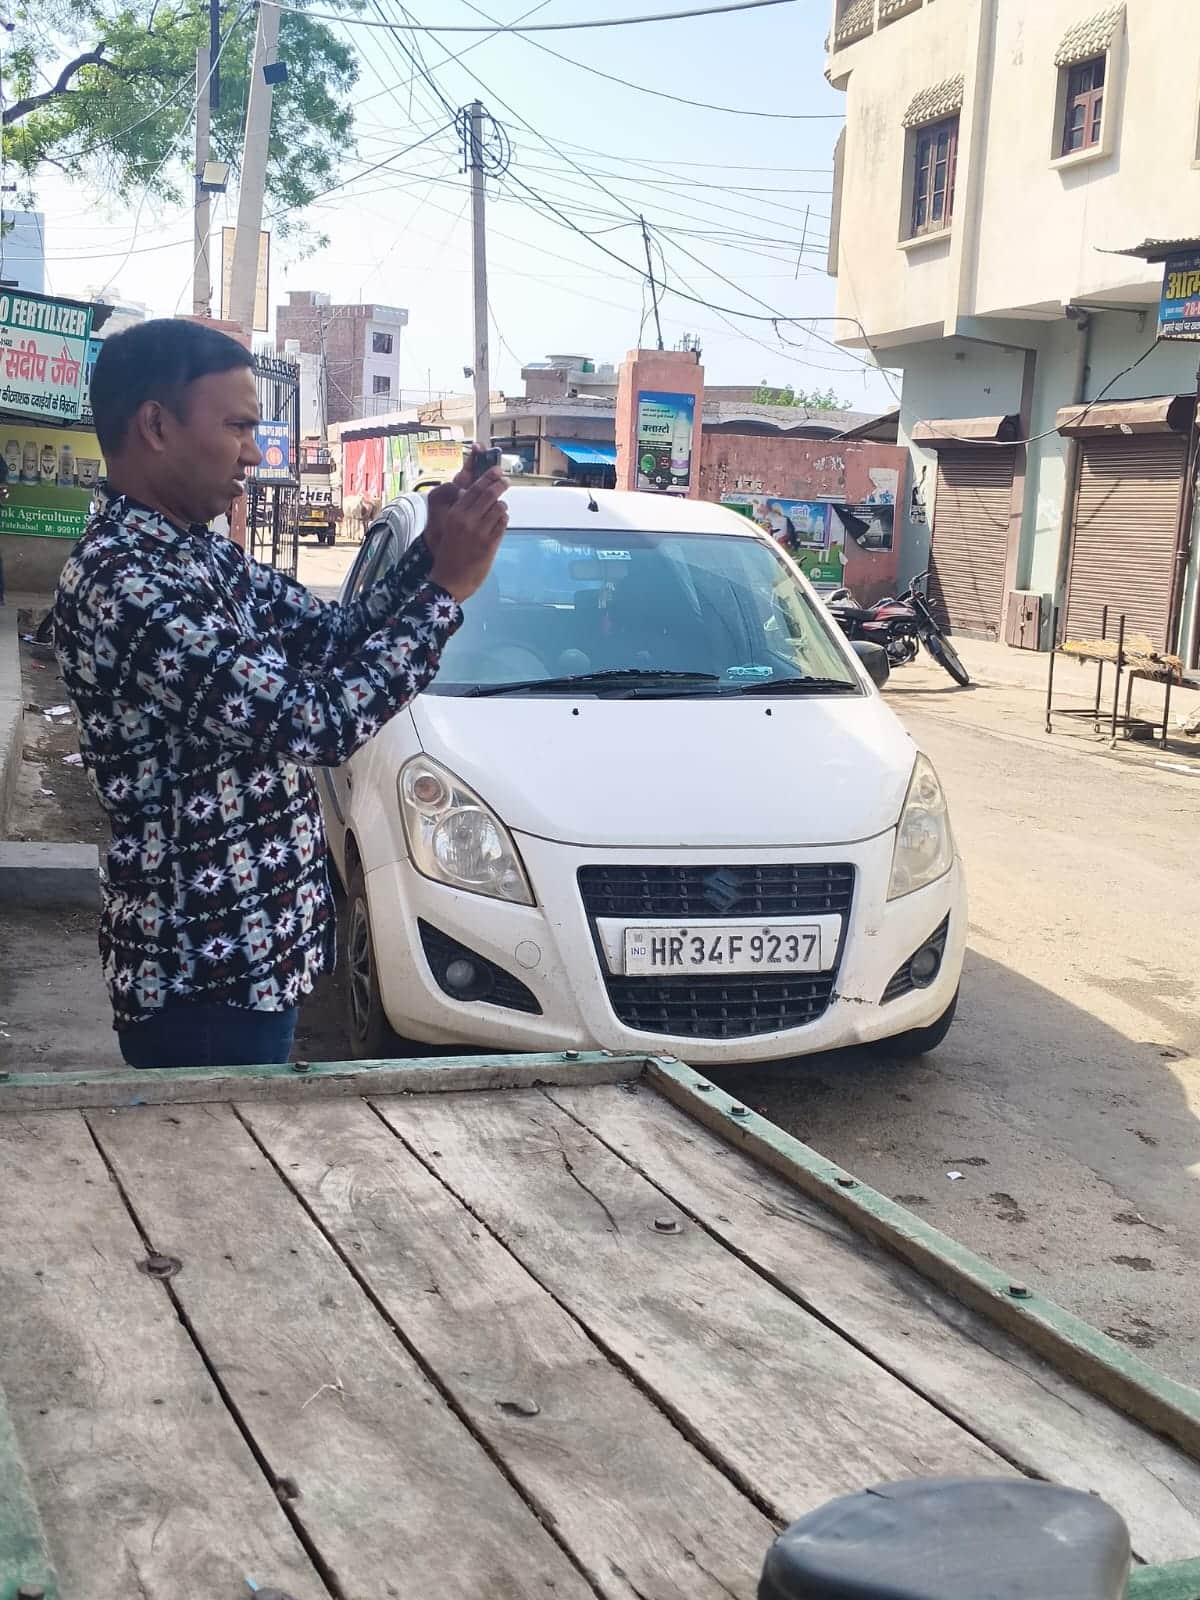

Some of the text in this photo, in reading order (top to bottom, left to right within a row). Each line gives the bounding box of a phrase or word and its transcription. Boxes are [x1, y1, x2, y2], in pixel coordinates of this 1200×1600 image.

[11, 298, 87, 337] FERTILIZER
[6, 340, 81, 388] संदीप जैन
[52, 394, 59, 409] के
[18, 508, 81, 524] Agriculture
[630, 946, 646, 956] IND
[650, 937, 684, 966] HR
[690, 935, 723, 965] 34
[750, 934, 817, 963] 9237
